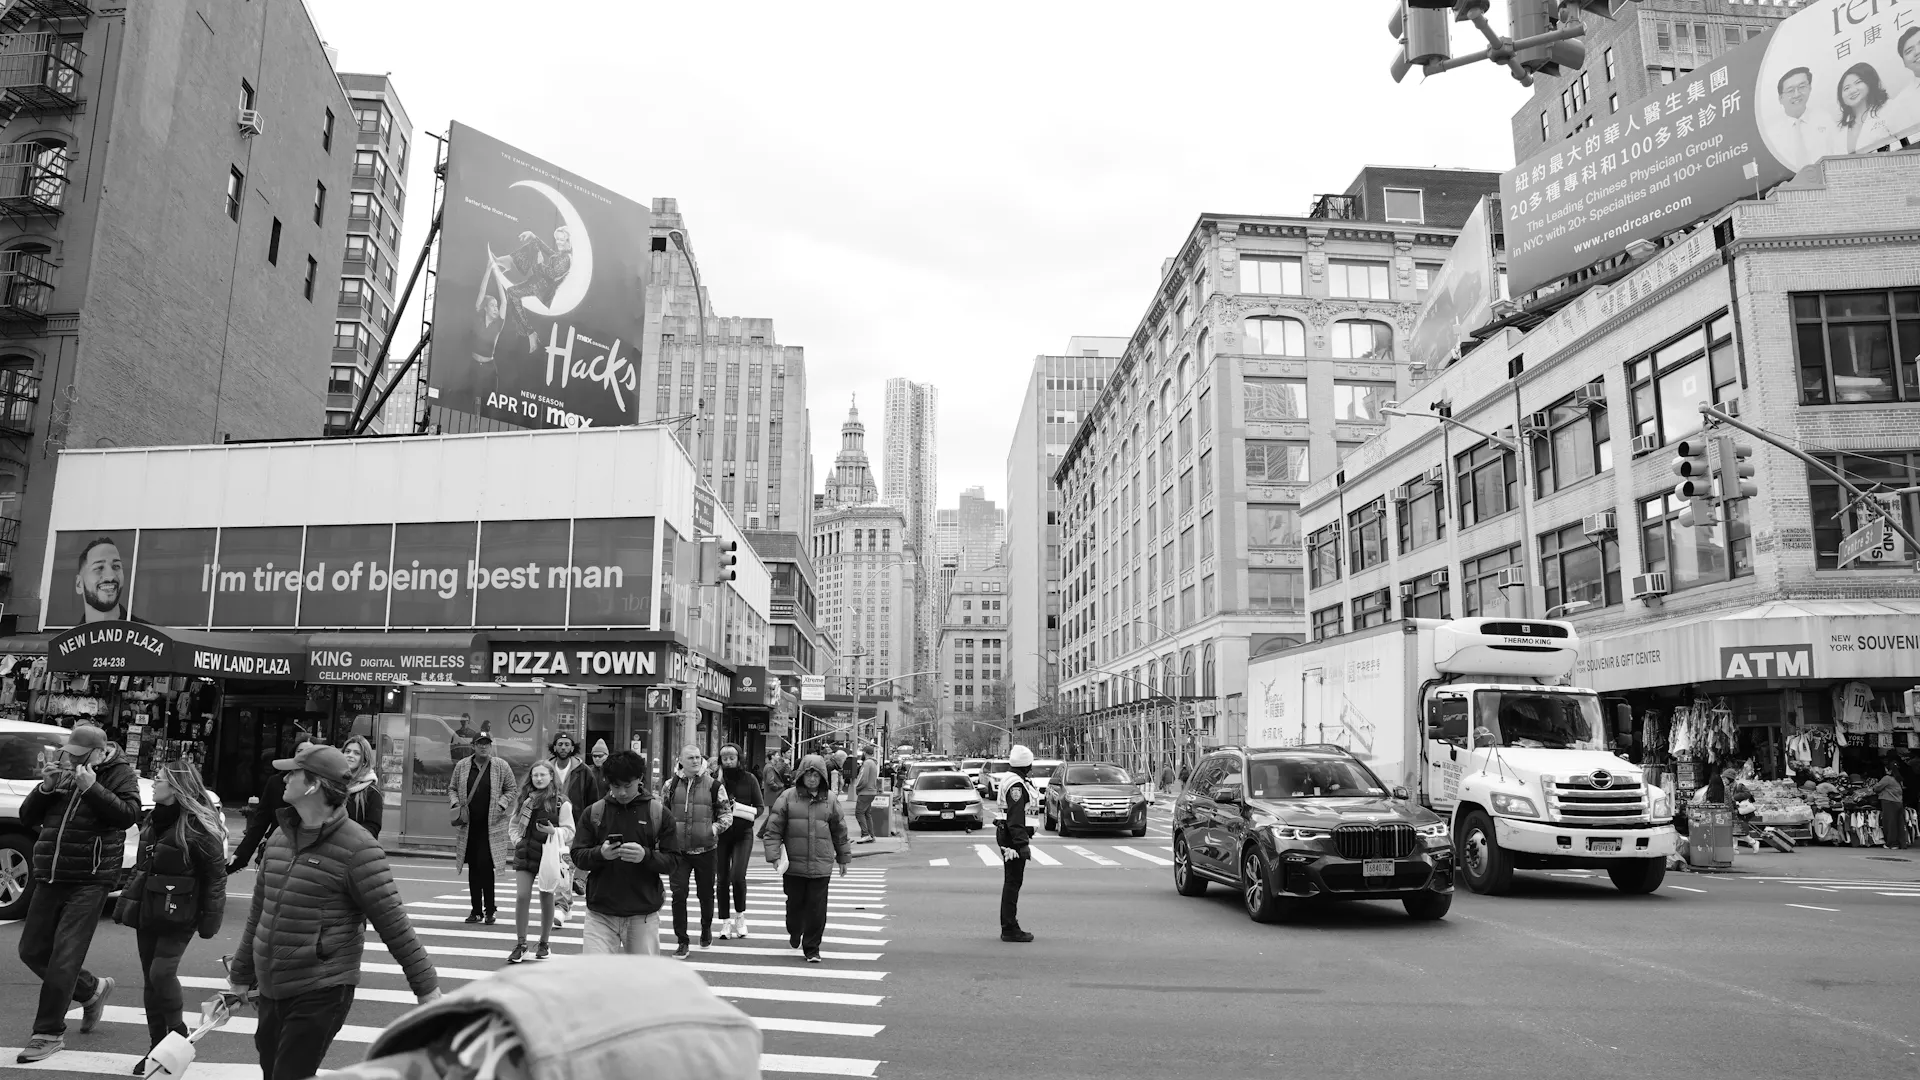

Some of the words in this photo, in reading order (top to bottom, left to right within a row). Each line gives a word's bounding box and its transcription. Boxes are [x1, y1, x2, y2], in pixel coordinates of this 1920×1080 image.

[1514, 65, 1729, 193] 紐約最大的華人醫生集團
[1510, 89, 1741, 221] 20多種專科和100多家診所
[1526, 217, 1544, 233] The
[1546, 199, 1584, 224] Leading
[1585, 178, 1627, 204] Chinese
[1629, 152, 1683, 183] Physician
[1685, 133, 1724, 157] Group
[1512, 246, 1521, 258] in
[1523, 234, 1544, 253] NYC
[1545, 224, 1566, 242] with
[1567, 215, 1587, 231] 20+
[1589, 187, 1647, 221] Specialties
[1649, 174, 1671, 194] and
[1672, 162, 1703, 183] 100+
[1705, 142, 1749, 168] Clinics
[1573, 195, 1692, 254] www.rendrcare.com
[544, 321, 636, 413] Hacks
[486, 391, 518, 414] APR
[521, 400, 538, 419] 10
[520, 389, 537, 400] NEW
[538, 394, 565, 408] SEASON
[546, 406, 594, 429] max
[1843, 536, 1864, 558] Centre
[1865, 530, 1874, 544] St
[201, 563, 246, 592] I'm
[252, 562, 325, 592] tired
[331, 561, 364, 591] of
[368, 559, 458, 600] being
[466, 559, 540, 590] best
[547, 565, 623, 589] man
[58, 633, 86, 656] NEW
[89, 628, 123, 644] LAND
[125, 629, 164, 657] PLAZA
[1503, 637, 1534, 645] THERMO
[1831, 634, 1851, 642] NEW
[1857, 635, 1920, 650] SOUVENI
[92, 657, 126, 668] 234-238
[194, 650, 222, 671] NEW
[223, 654, 254, 674] LAND
[255, 657, 291, 675] PLAZA
[310, 650, 353, 667] KING
[360, 658, 395, 668] DIGITAL
[400, 655, 465, 668] WIRELESS
[492, 651, 570, 675] PIZZA
[576, 650, 657, 675] TOWN
[1586, 657, 1615, 672] SOUVENIR
[1615, 656, 1620, 668] &
[1620, 653, 1634, 667] GIFT
[1635, 649, 1661, 666] CENTER
[1726, 651, 1810, 678] ATM
[318, 671, 373, 681] CELLPHONE
[375, 672, 409, 681] REPAIR
[494, 675, 508, 683] 234
[707, 666, 731, 698] TOWN
[1853, 694, 1865, 708] 10
[511, 713, 531, 725] AG
